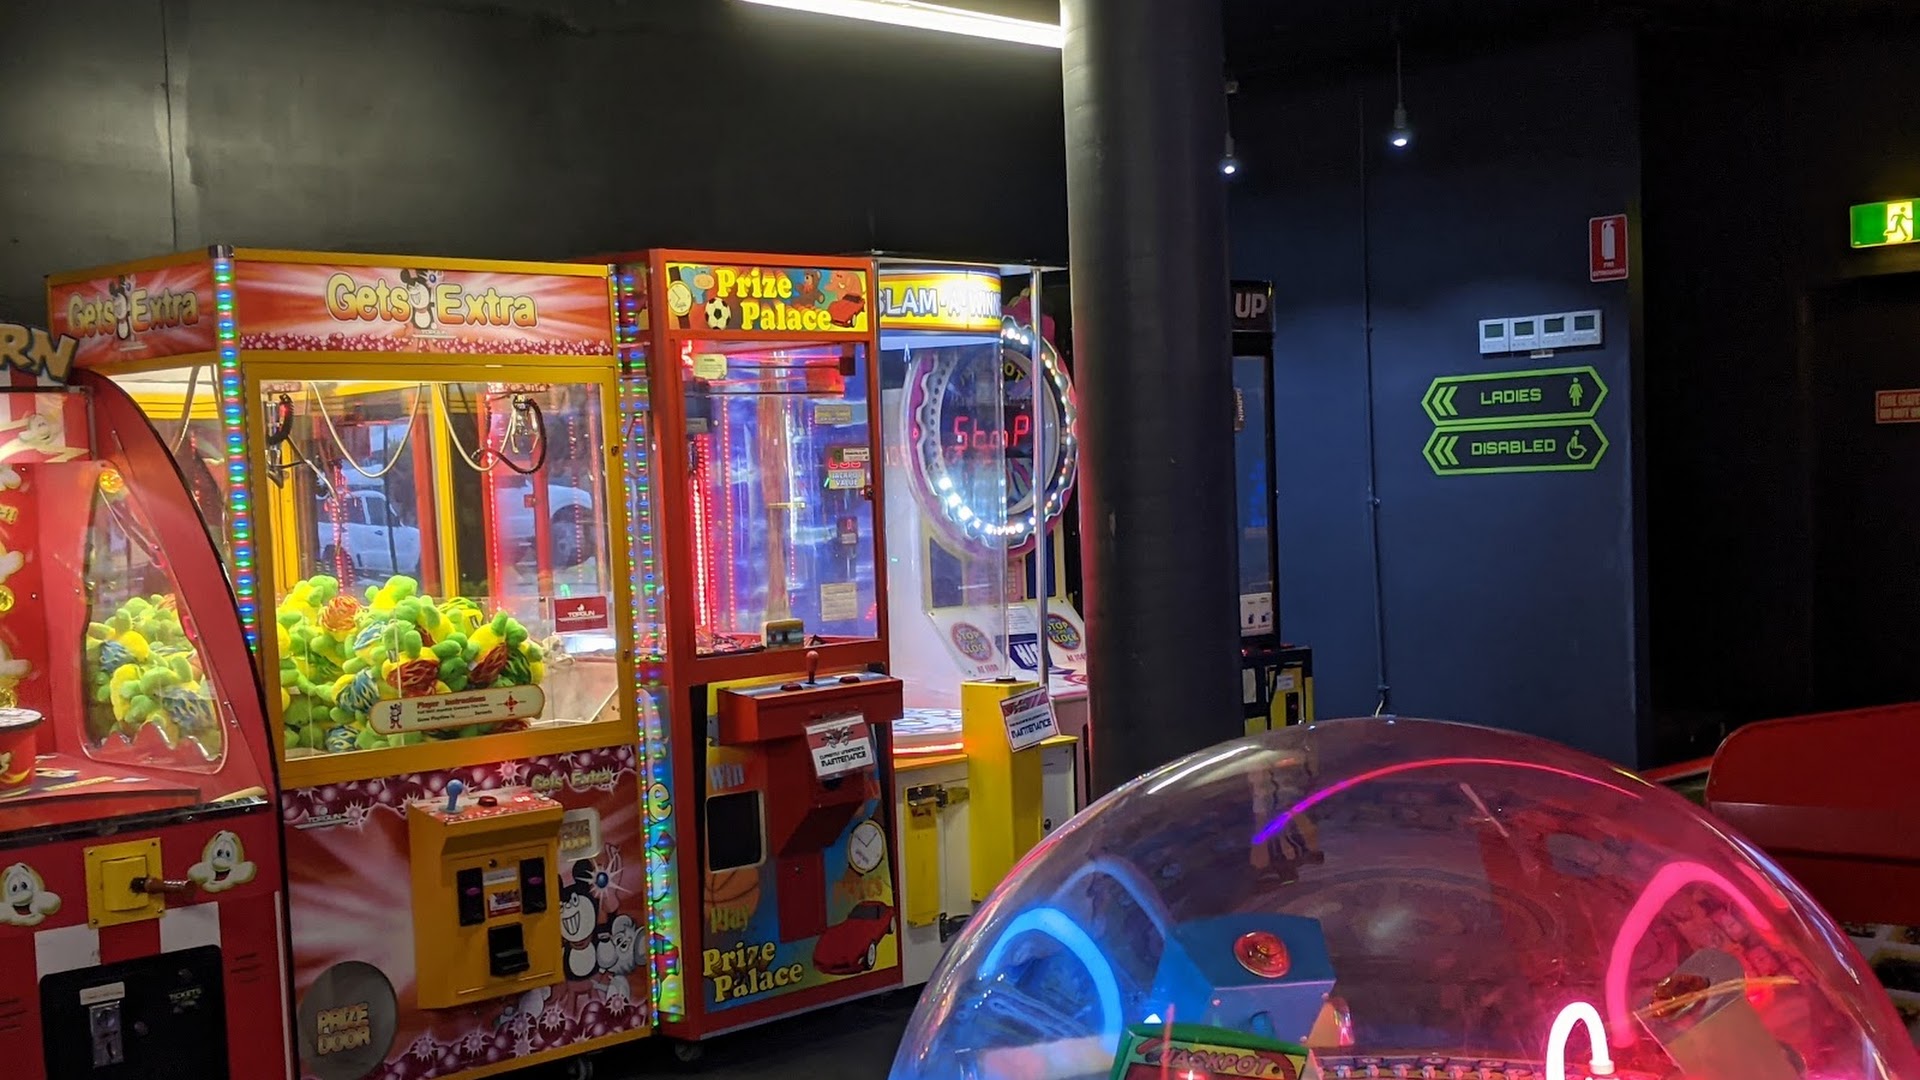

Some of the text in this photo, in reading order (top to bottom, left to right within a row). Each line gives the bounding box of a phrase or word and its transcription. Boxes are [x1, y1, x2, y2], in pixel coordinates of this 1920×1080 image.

[715, 269, 793, 299] Prize
[66, 287, 200, 339] Gets Extra
[326, 273, 539, 328] Gets Extra
[740, 300, 833, 331] Palace
[1234, 292, 1267, 319] UP
[1480, 387, 1543, 406] LADIES
[1471, 437, 1556, 457] DISABLED
[703, 940, 776, 977] Prize
[713, 961, 804, 1003] Palace
